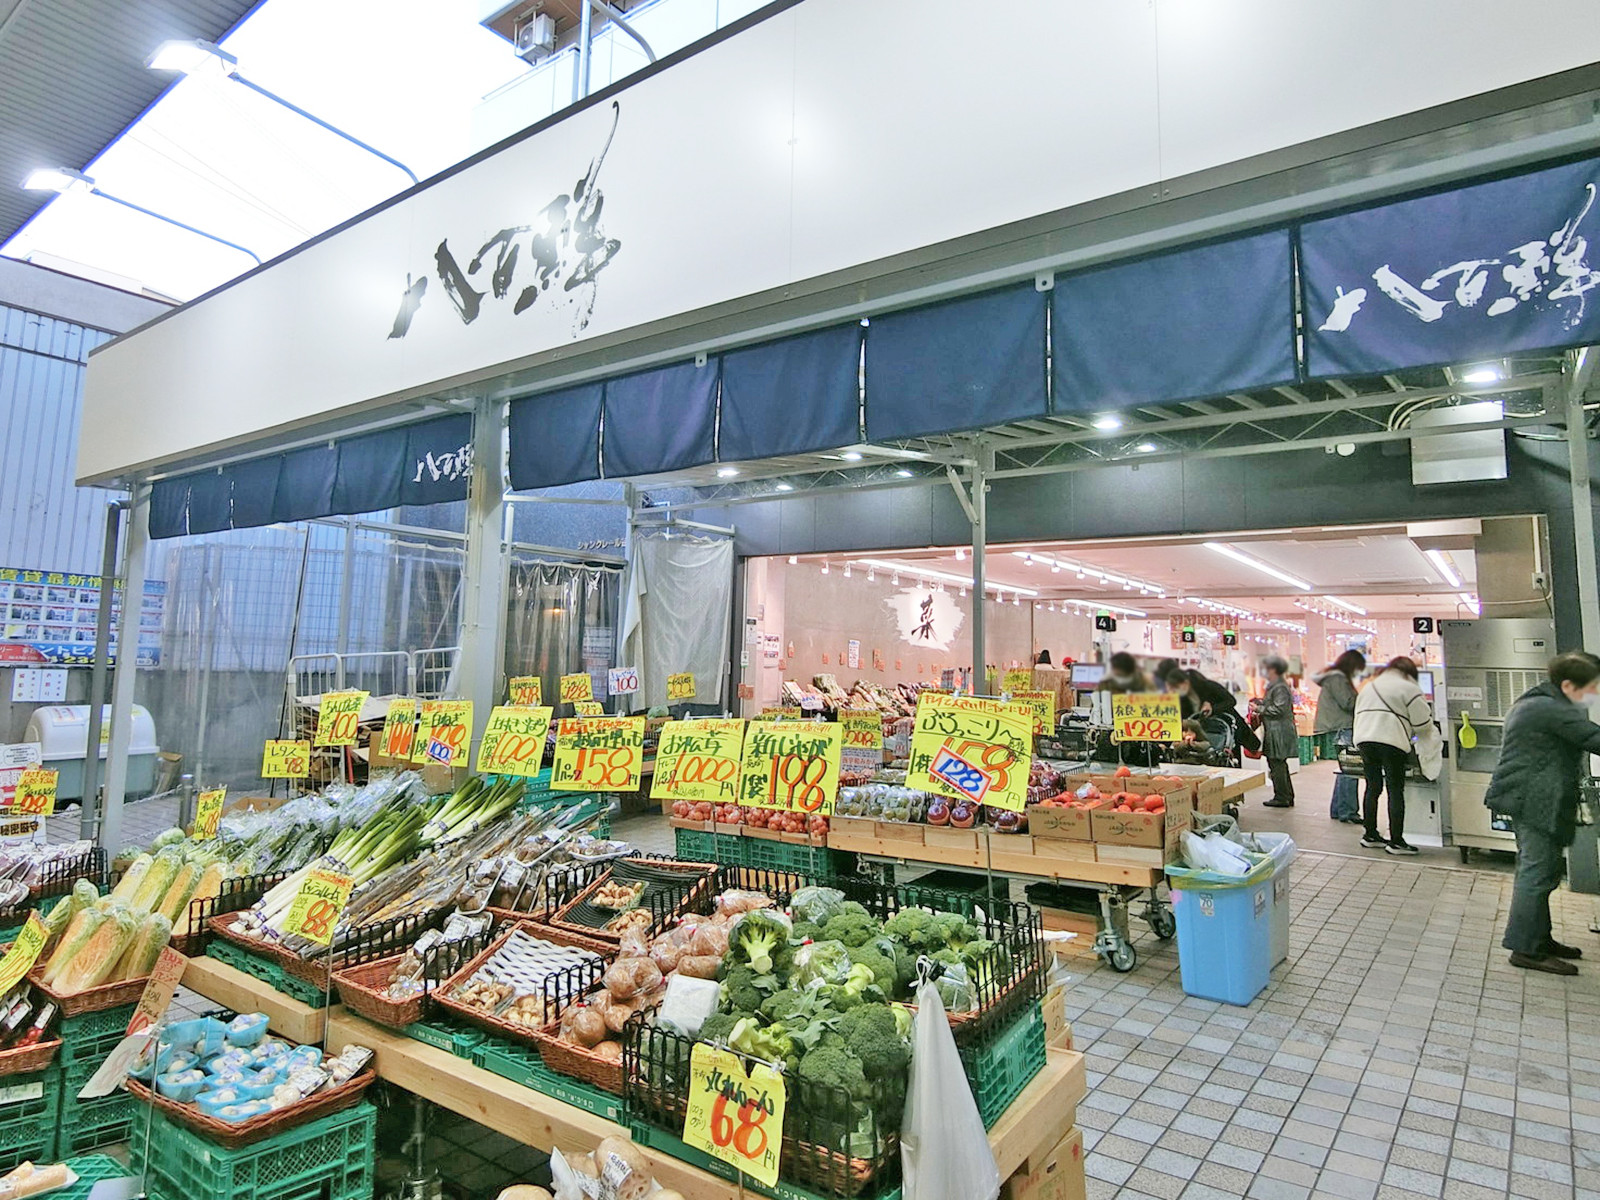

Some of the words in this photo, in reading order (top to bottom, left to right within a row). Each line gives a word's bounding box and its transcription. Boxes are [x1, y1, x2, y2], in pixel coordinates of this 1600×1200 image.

[1098, 619, 1106, 627] 4
[1418, 620, 1429, 631] 2
[1184, 633, 1192, 641] 8
[1226, 636, 1232, 644] 7
[271, 746, 297, 757] レタス
[430, 741, 450, 759] 100
[284, 756, 305, 774] 78
[938, 757, 983, 792] 128
